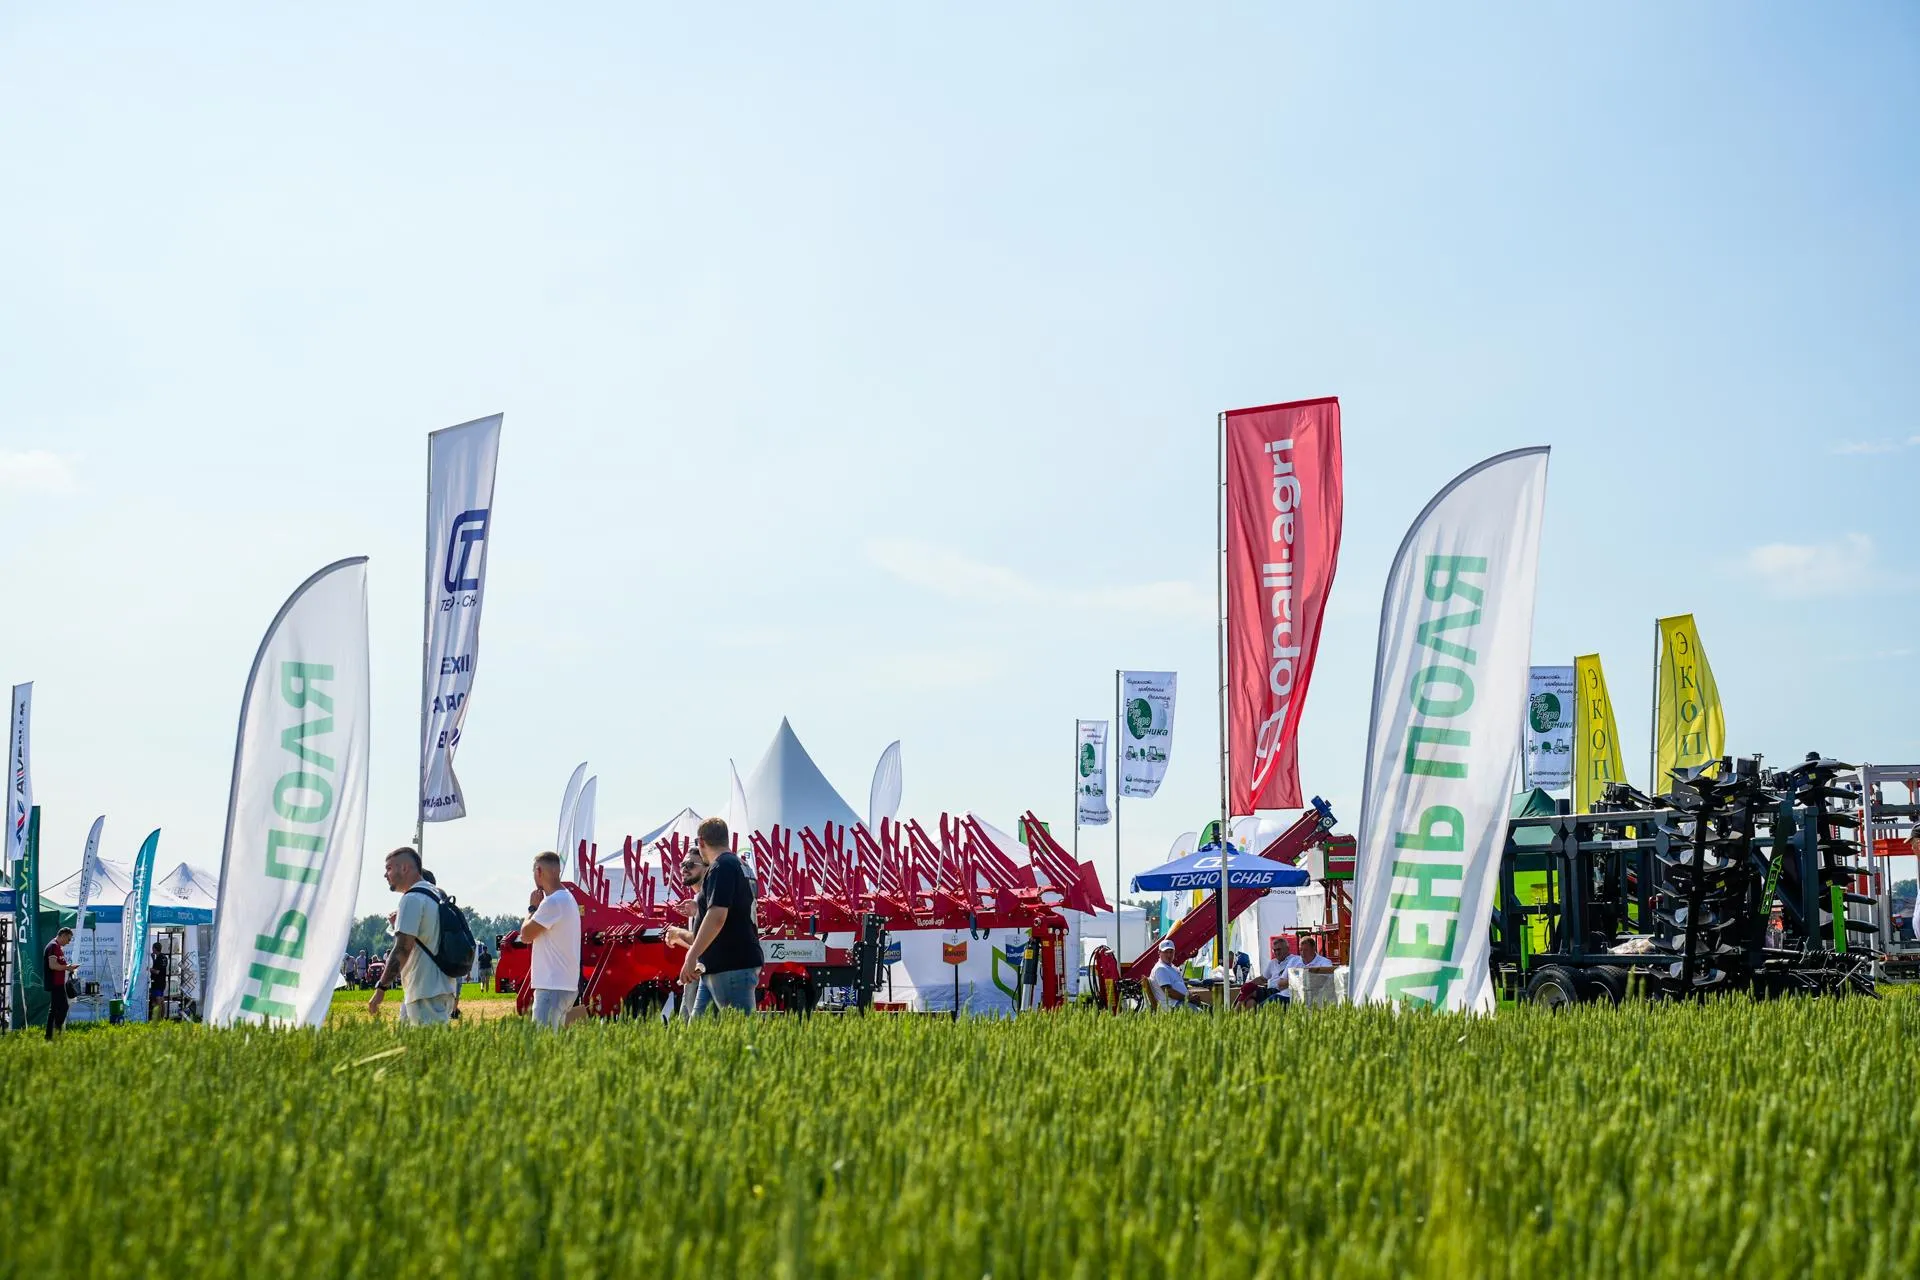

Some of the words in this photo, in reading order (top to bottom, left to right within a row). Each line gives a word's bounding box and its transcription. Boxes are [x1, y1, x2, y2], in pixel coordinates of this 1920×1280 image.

[1263, 438, 1301, 696] opall-agri
[1403, 554, 1488, 779] ПОЛЯ
[264, 661, 336, 885] ПОЛЯ
[1170, 872, 1219, 888] ТЕХНО
[1230, 871, 1274, 884] СНАБ
[239, 909, 309, 1019] НЬ
